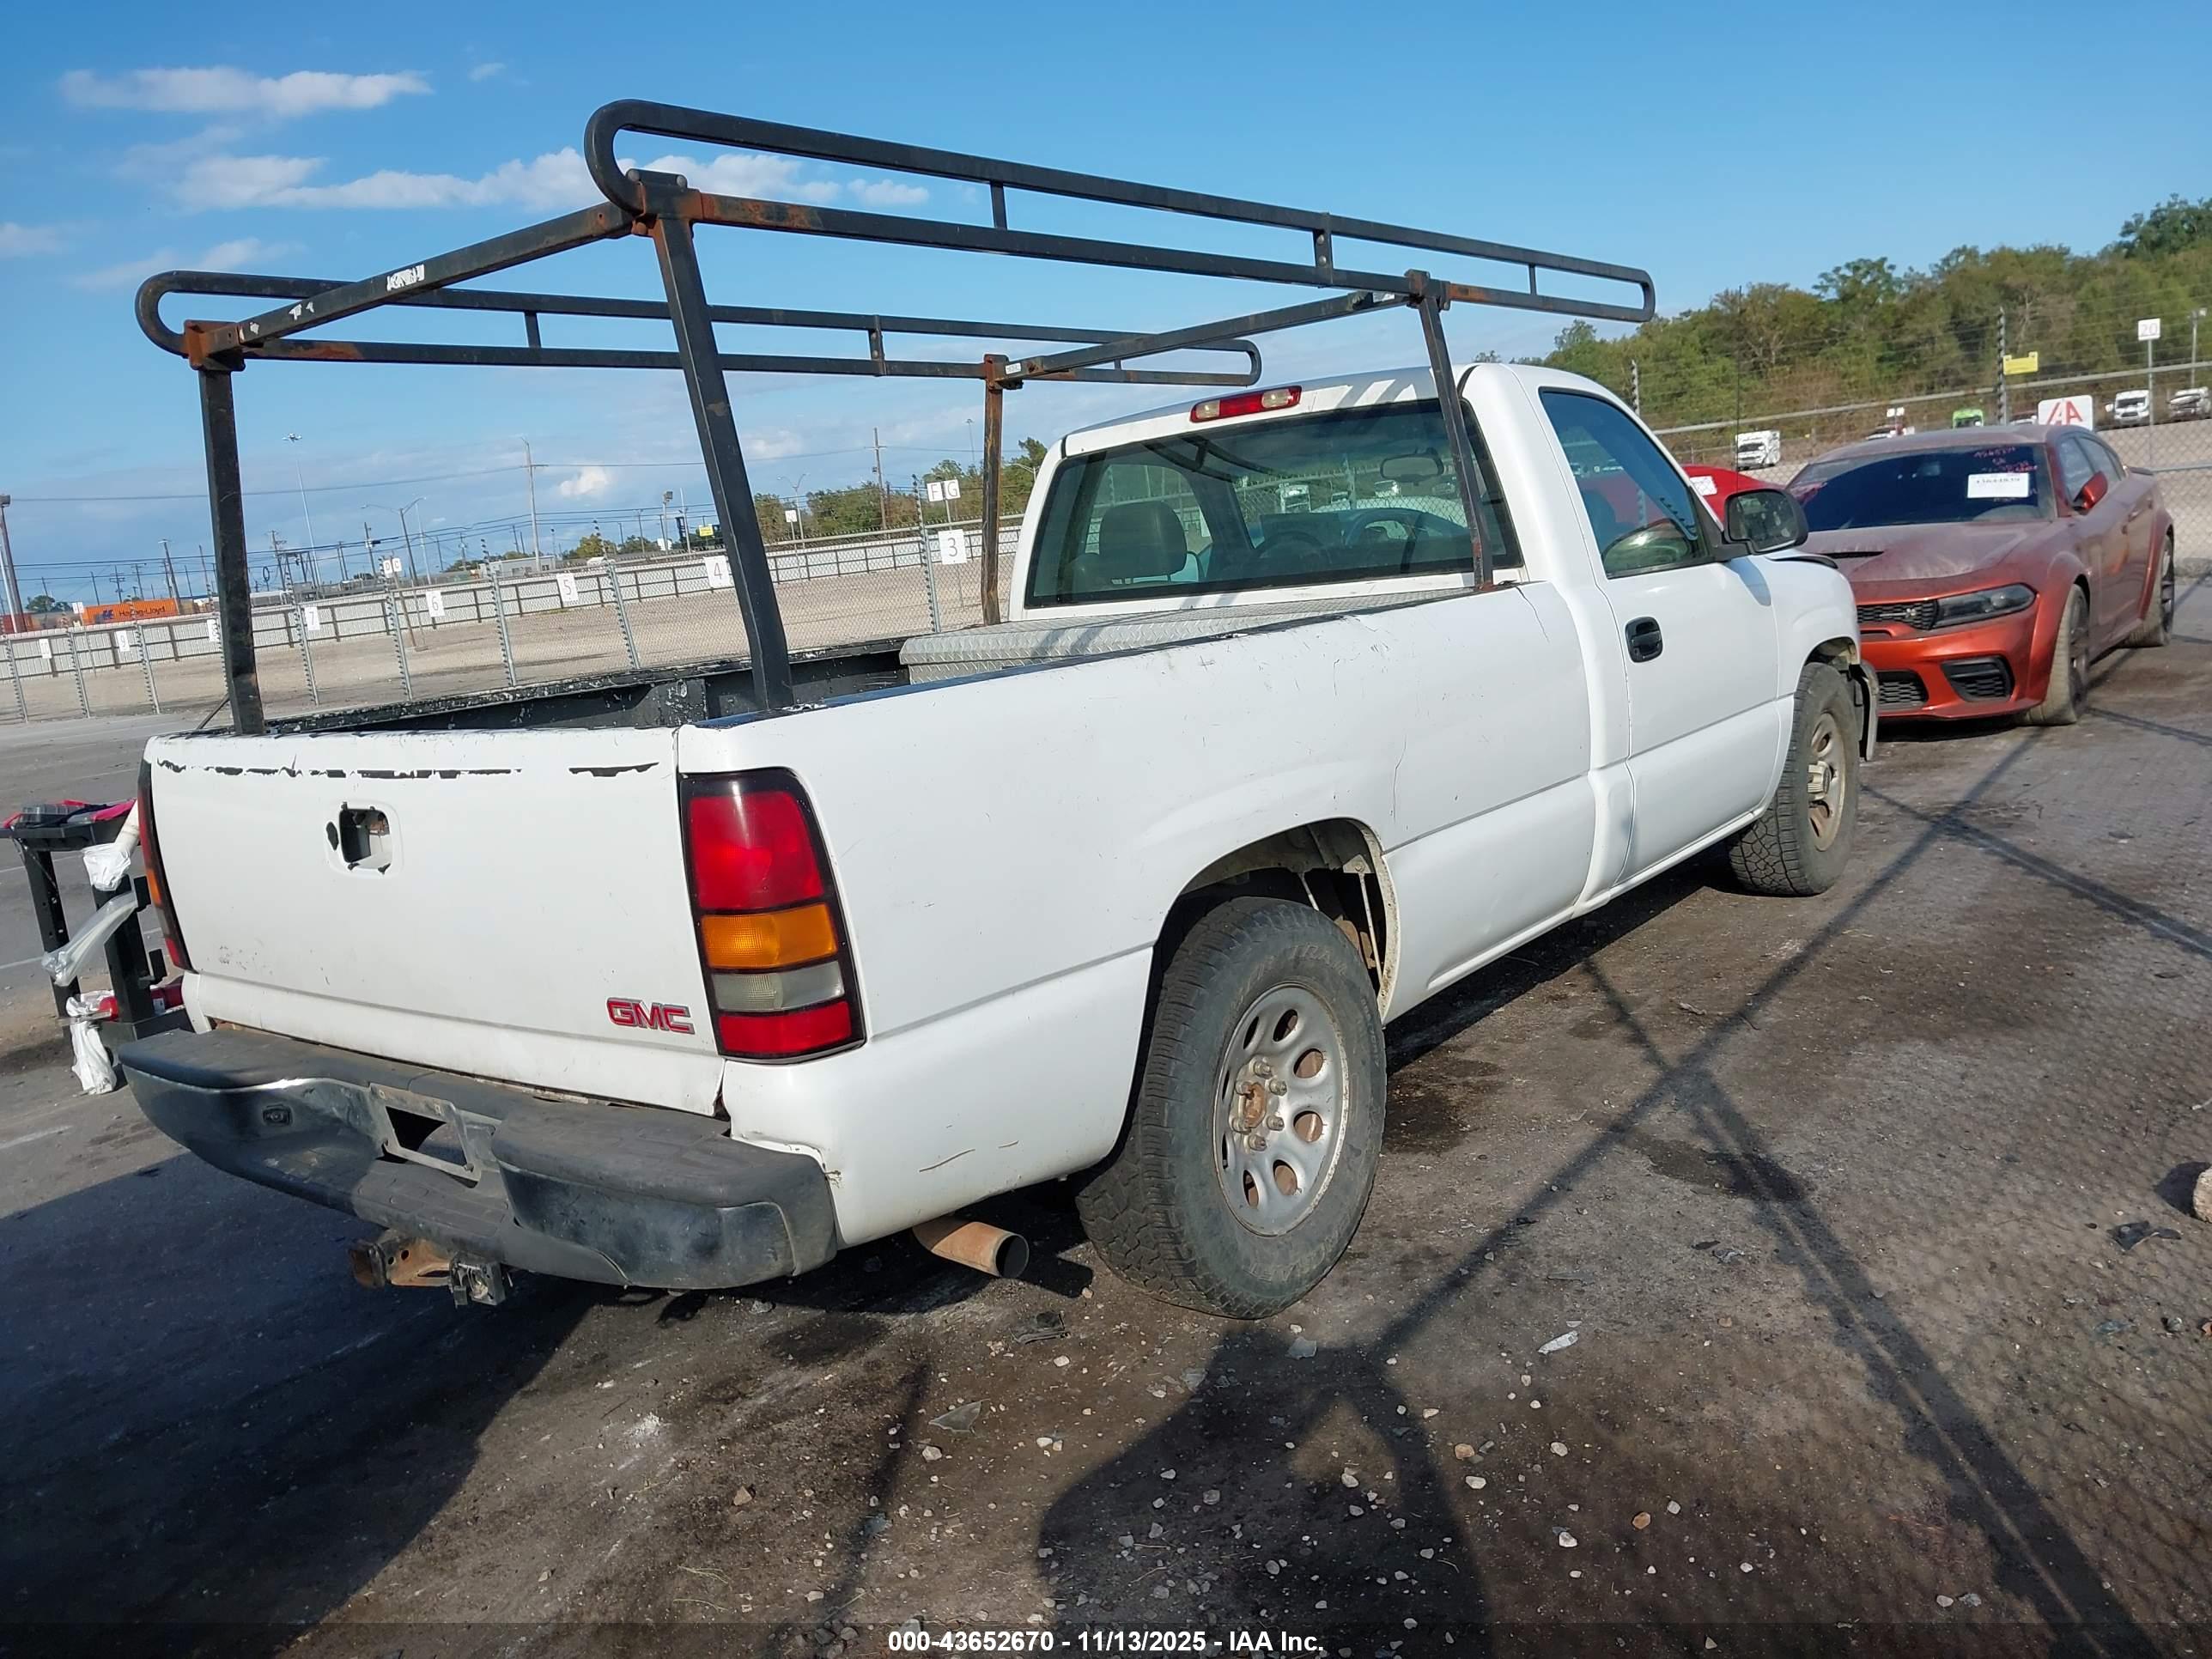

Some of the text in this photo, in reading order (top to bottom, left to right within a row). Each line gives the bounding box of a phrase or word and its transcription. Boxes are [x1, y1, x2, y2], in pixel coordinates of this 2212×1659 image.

[930, 483, 938, 500] F
[947, 481, 957, 497] G
[947, 537, 957, 557] 3
[714, 562, 723, 580] 4
[563, 580, 572, 595] 5
[432, 596, 439, 611] 6
[307, 611, 315, 626] 7
[120, 635, 126, 647] 9
[606, 997, 696, 1036] GMC
